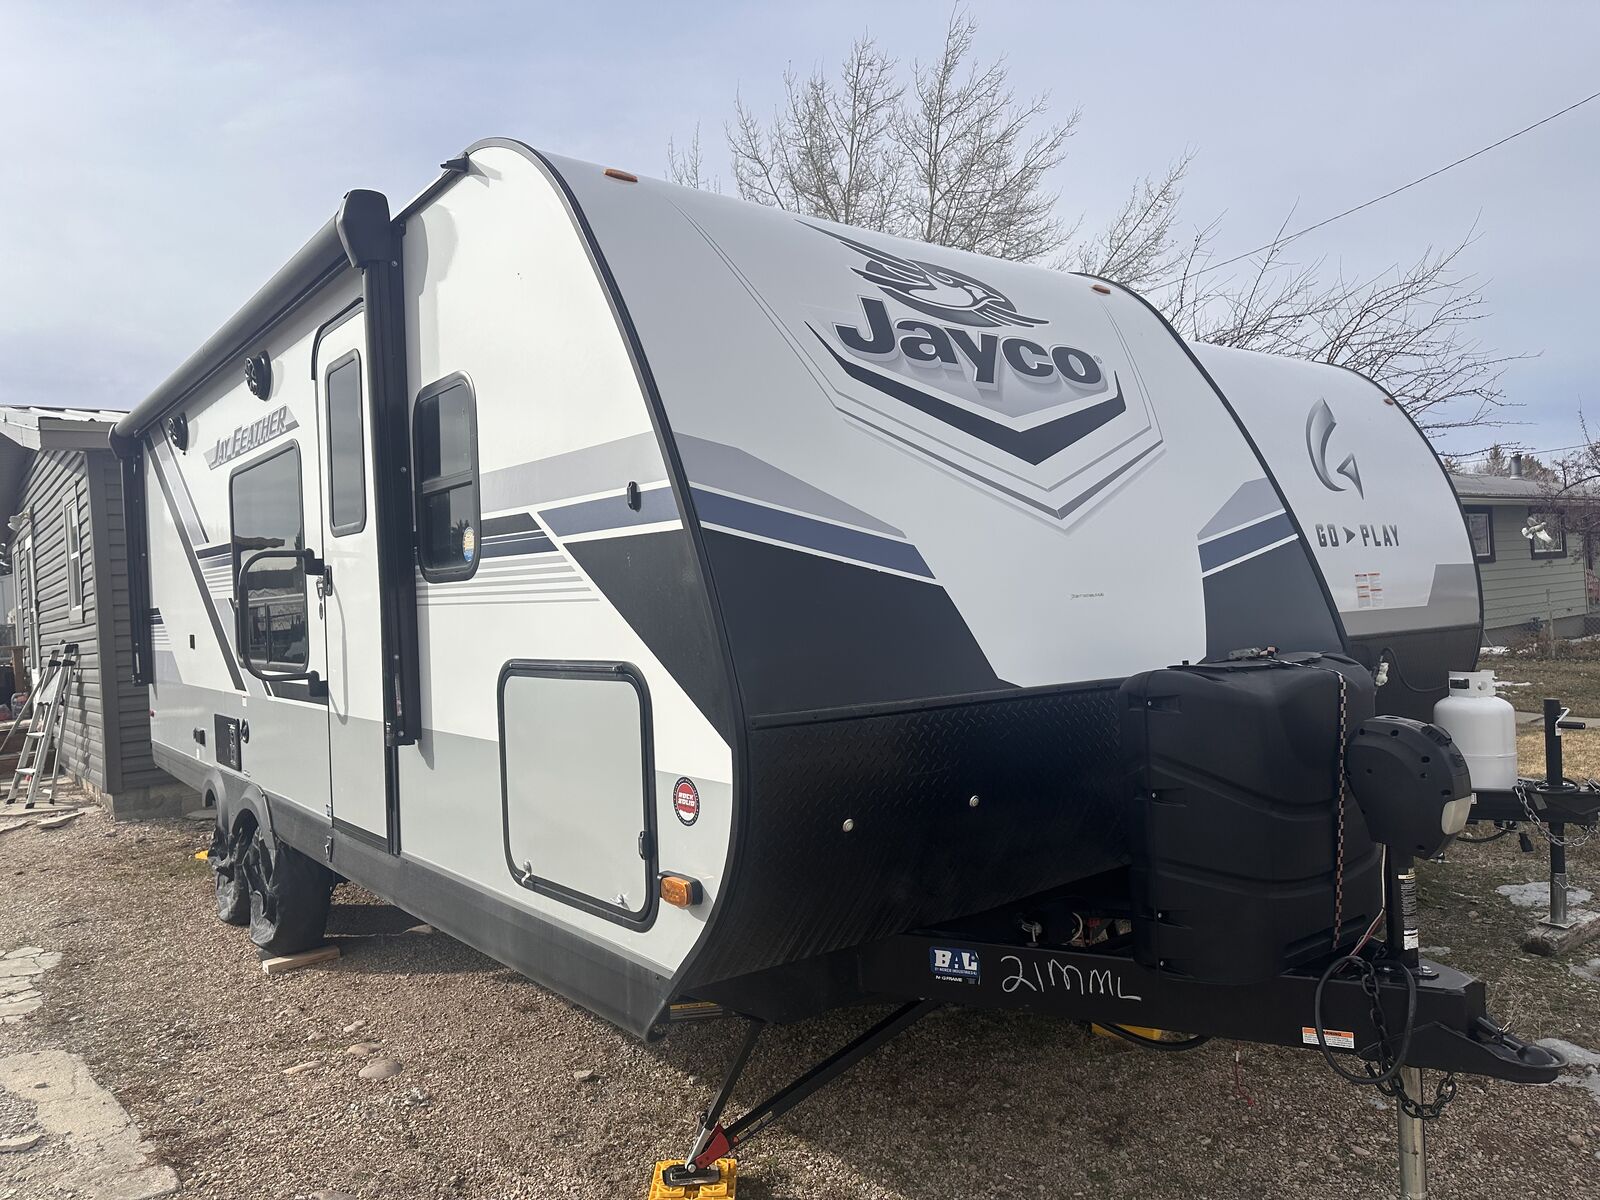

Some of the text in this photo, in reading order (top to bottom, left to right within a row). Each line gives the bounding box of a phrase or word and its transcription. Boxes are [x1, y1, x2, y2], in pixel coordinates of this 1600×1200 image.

[833, 296, 1103, 386] Jayco
[230, 404, 288, 458] FEATHER
[1315, 523, 1400, 548] GO PLAY
[678, 791, 694, 801] ROCK
[934, 949, 978, 971] BAL
